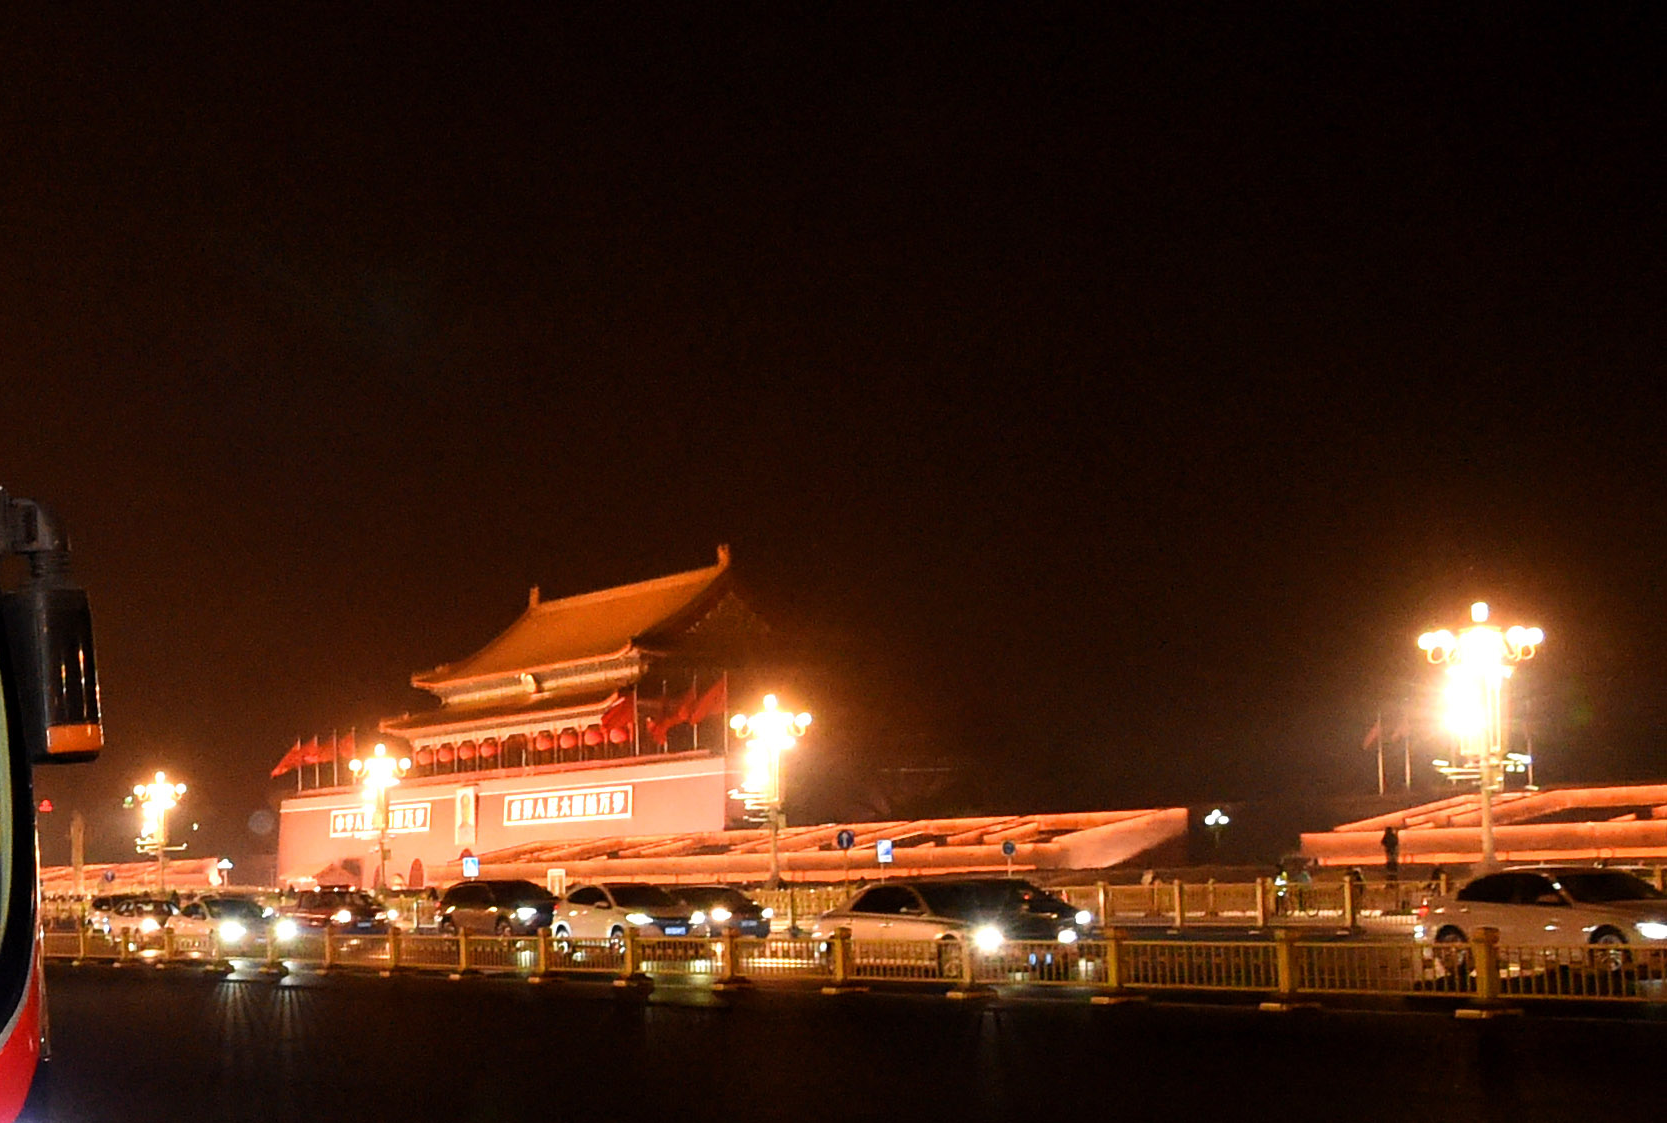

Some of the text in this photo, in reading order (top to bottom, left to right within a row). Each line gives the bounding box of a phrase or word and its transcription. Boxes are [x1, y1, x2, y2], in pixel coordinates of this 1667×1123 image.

[335, 807, 425, 832] 中华人民国万岁
